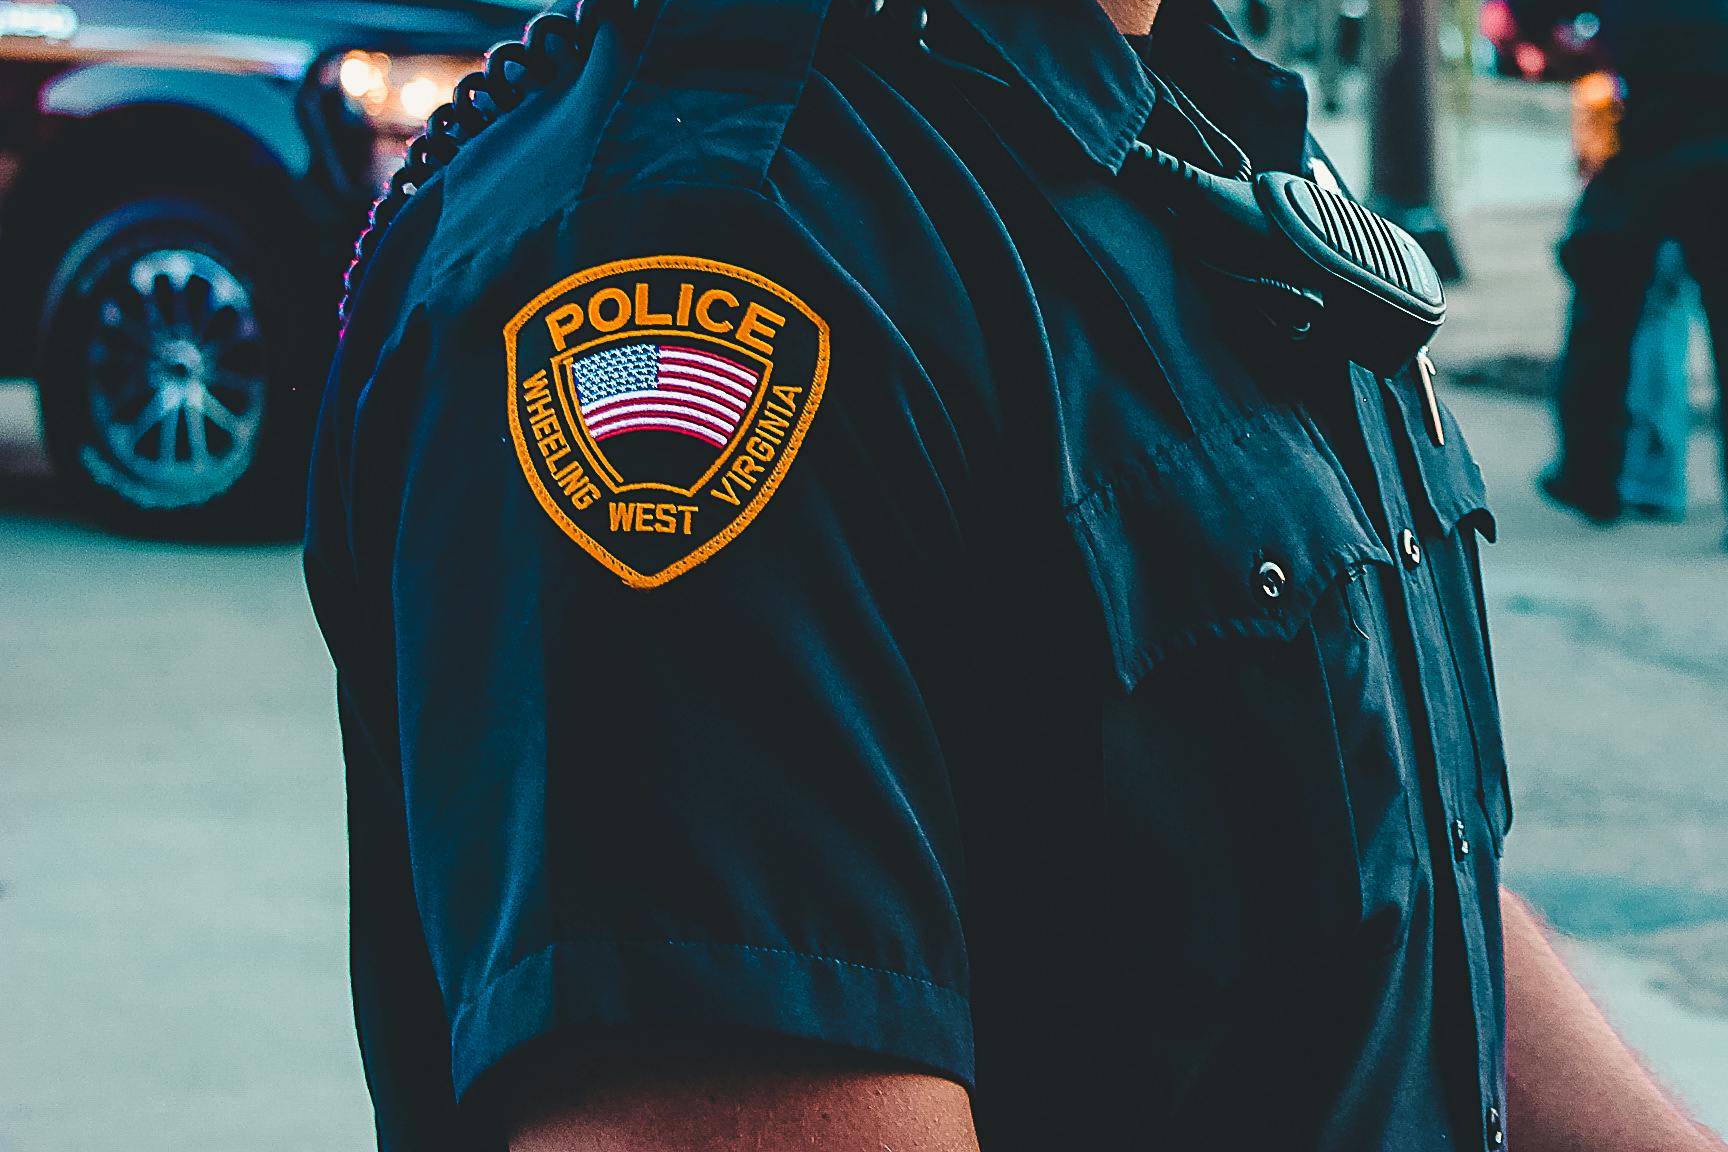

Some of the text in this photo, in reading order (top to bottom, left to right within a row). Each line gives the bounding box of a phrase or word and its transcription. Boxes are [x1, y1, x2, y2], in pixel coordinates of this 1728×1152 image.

[545, 283, 786, 355] POLICE
[522, 369, 803, 535] WHEELING WEST VIRGINIA
